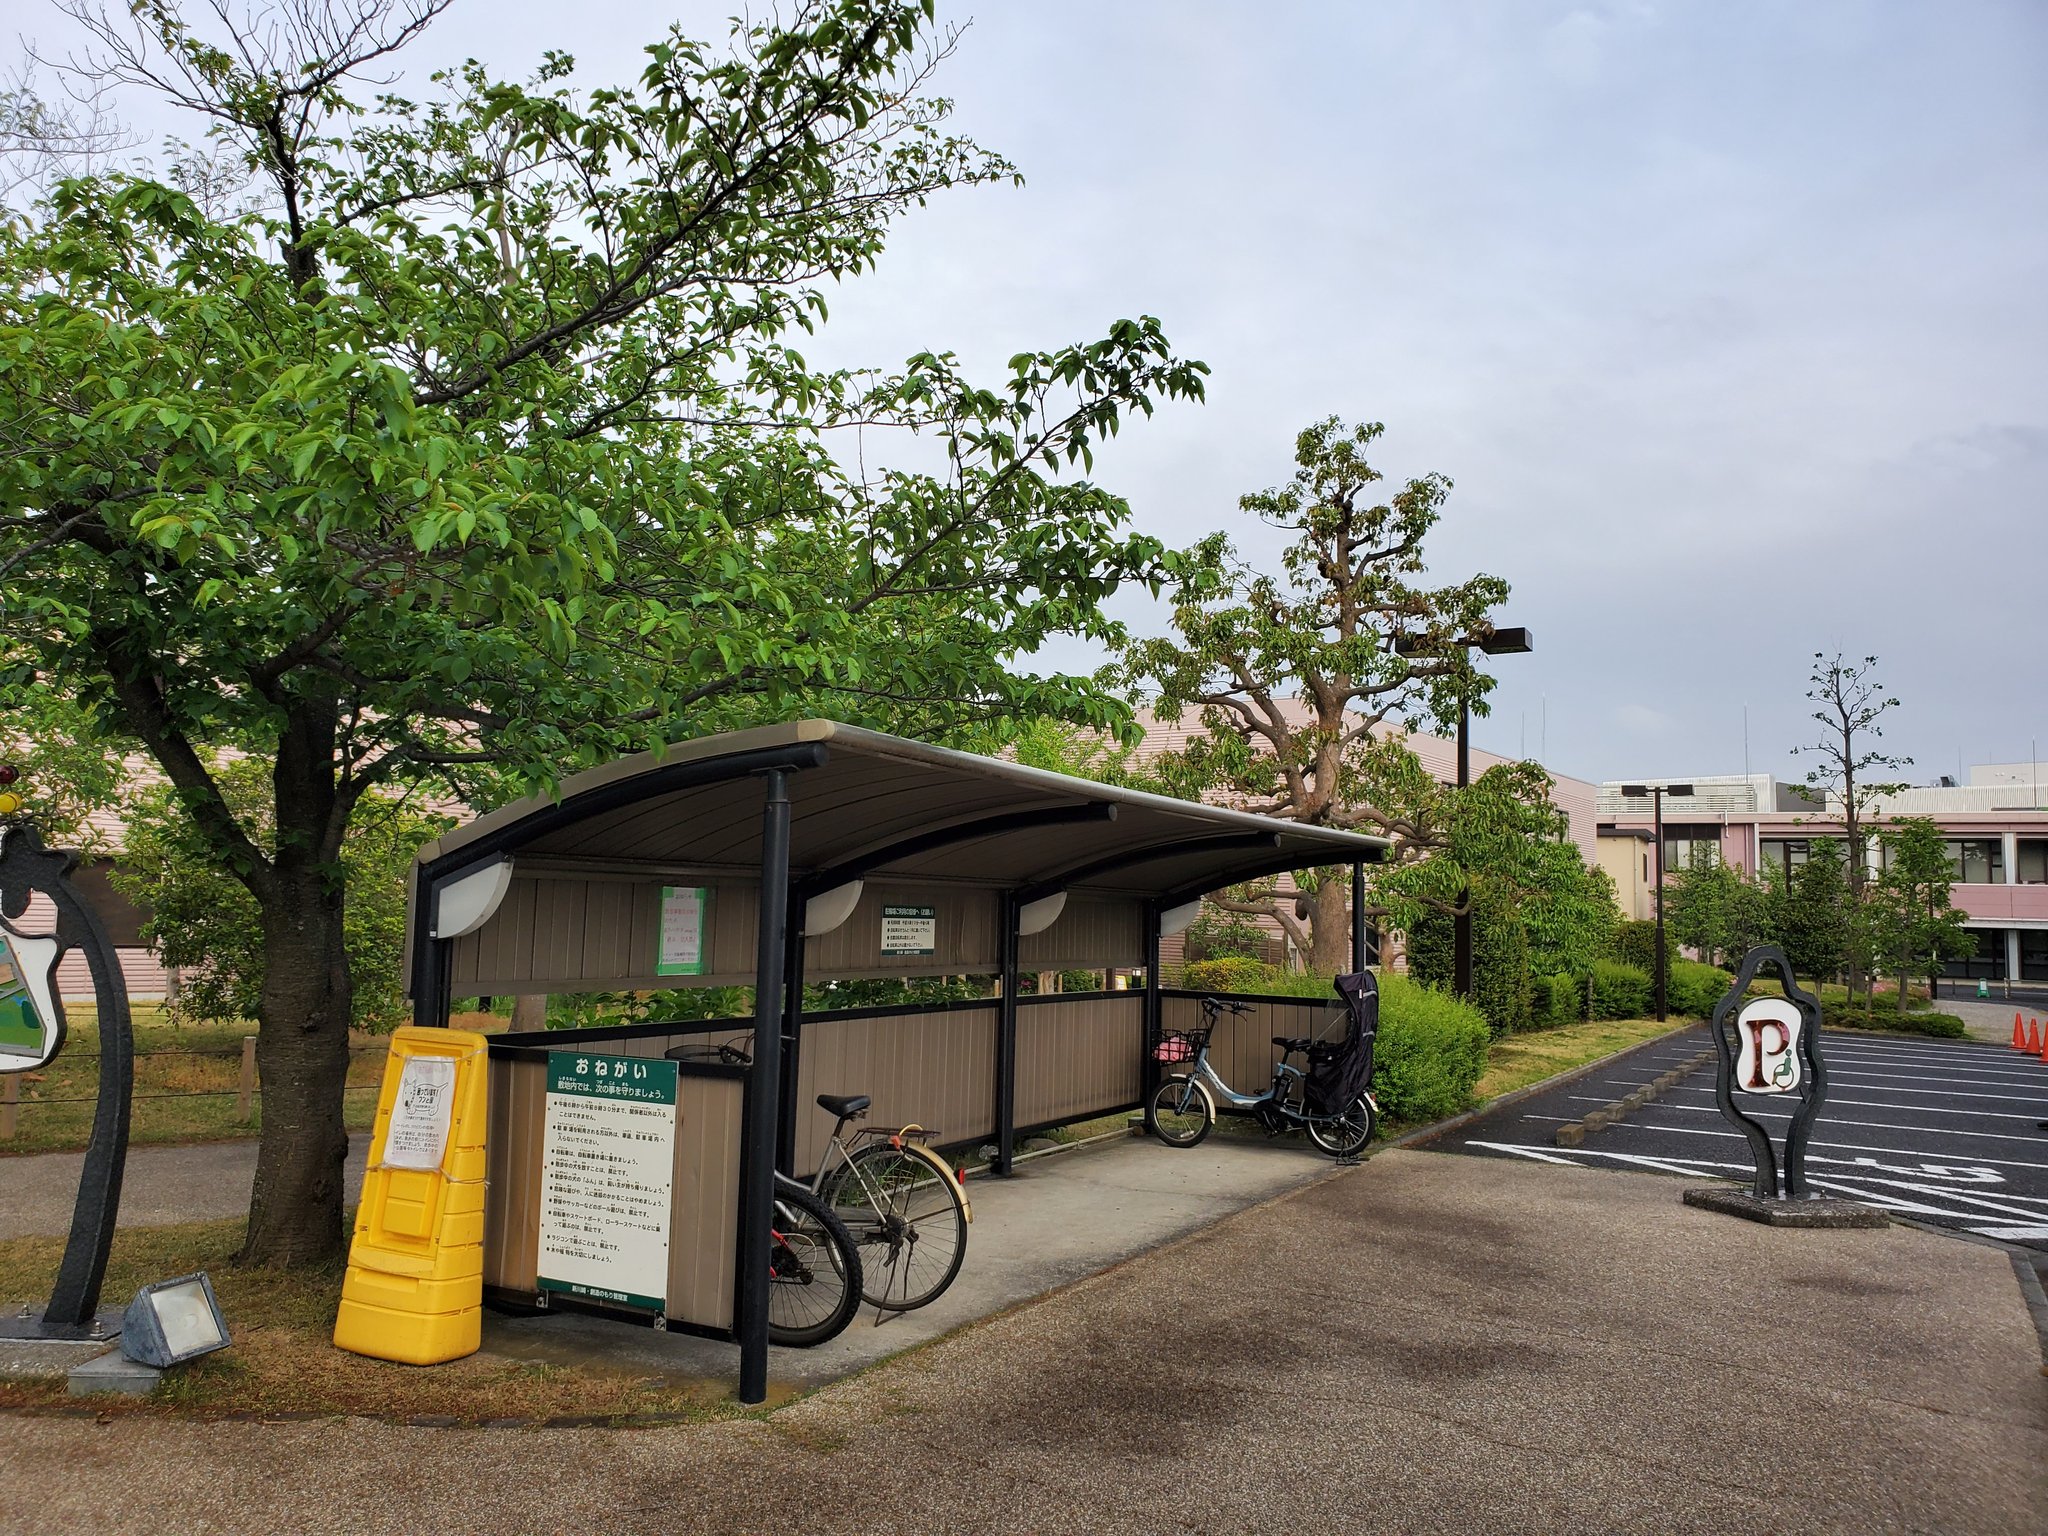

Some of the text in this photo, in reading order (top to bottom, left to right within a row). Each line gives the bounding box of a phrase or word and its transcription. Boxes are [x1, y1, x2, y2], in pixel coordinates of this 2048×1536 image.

[1745, 1018, 1791, 1088] P
[576, 1058, 647, 1079] おねがい
[557, 1080, 665, 1100] 敷地内では、次の事を守りましょう。
[559, 1111, 597, 1121] ことはできません。
[557, 1135, 600, 1146] 入らないでください。
